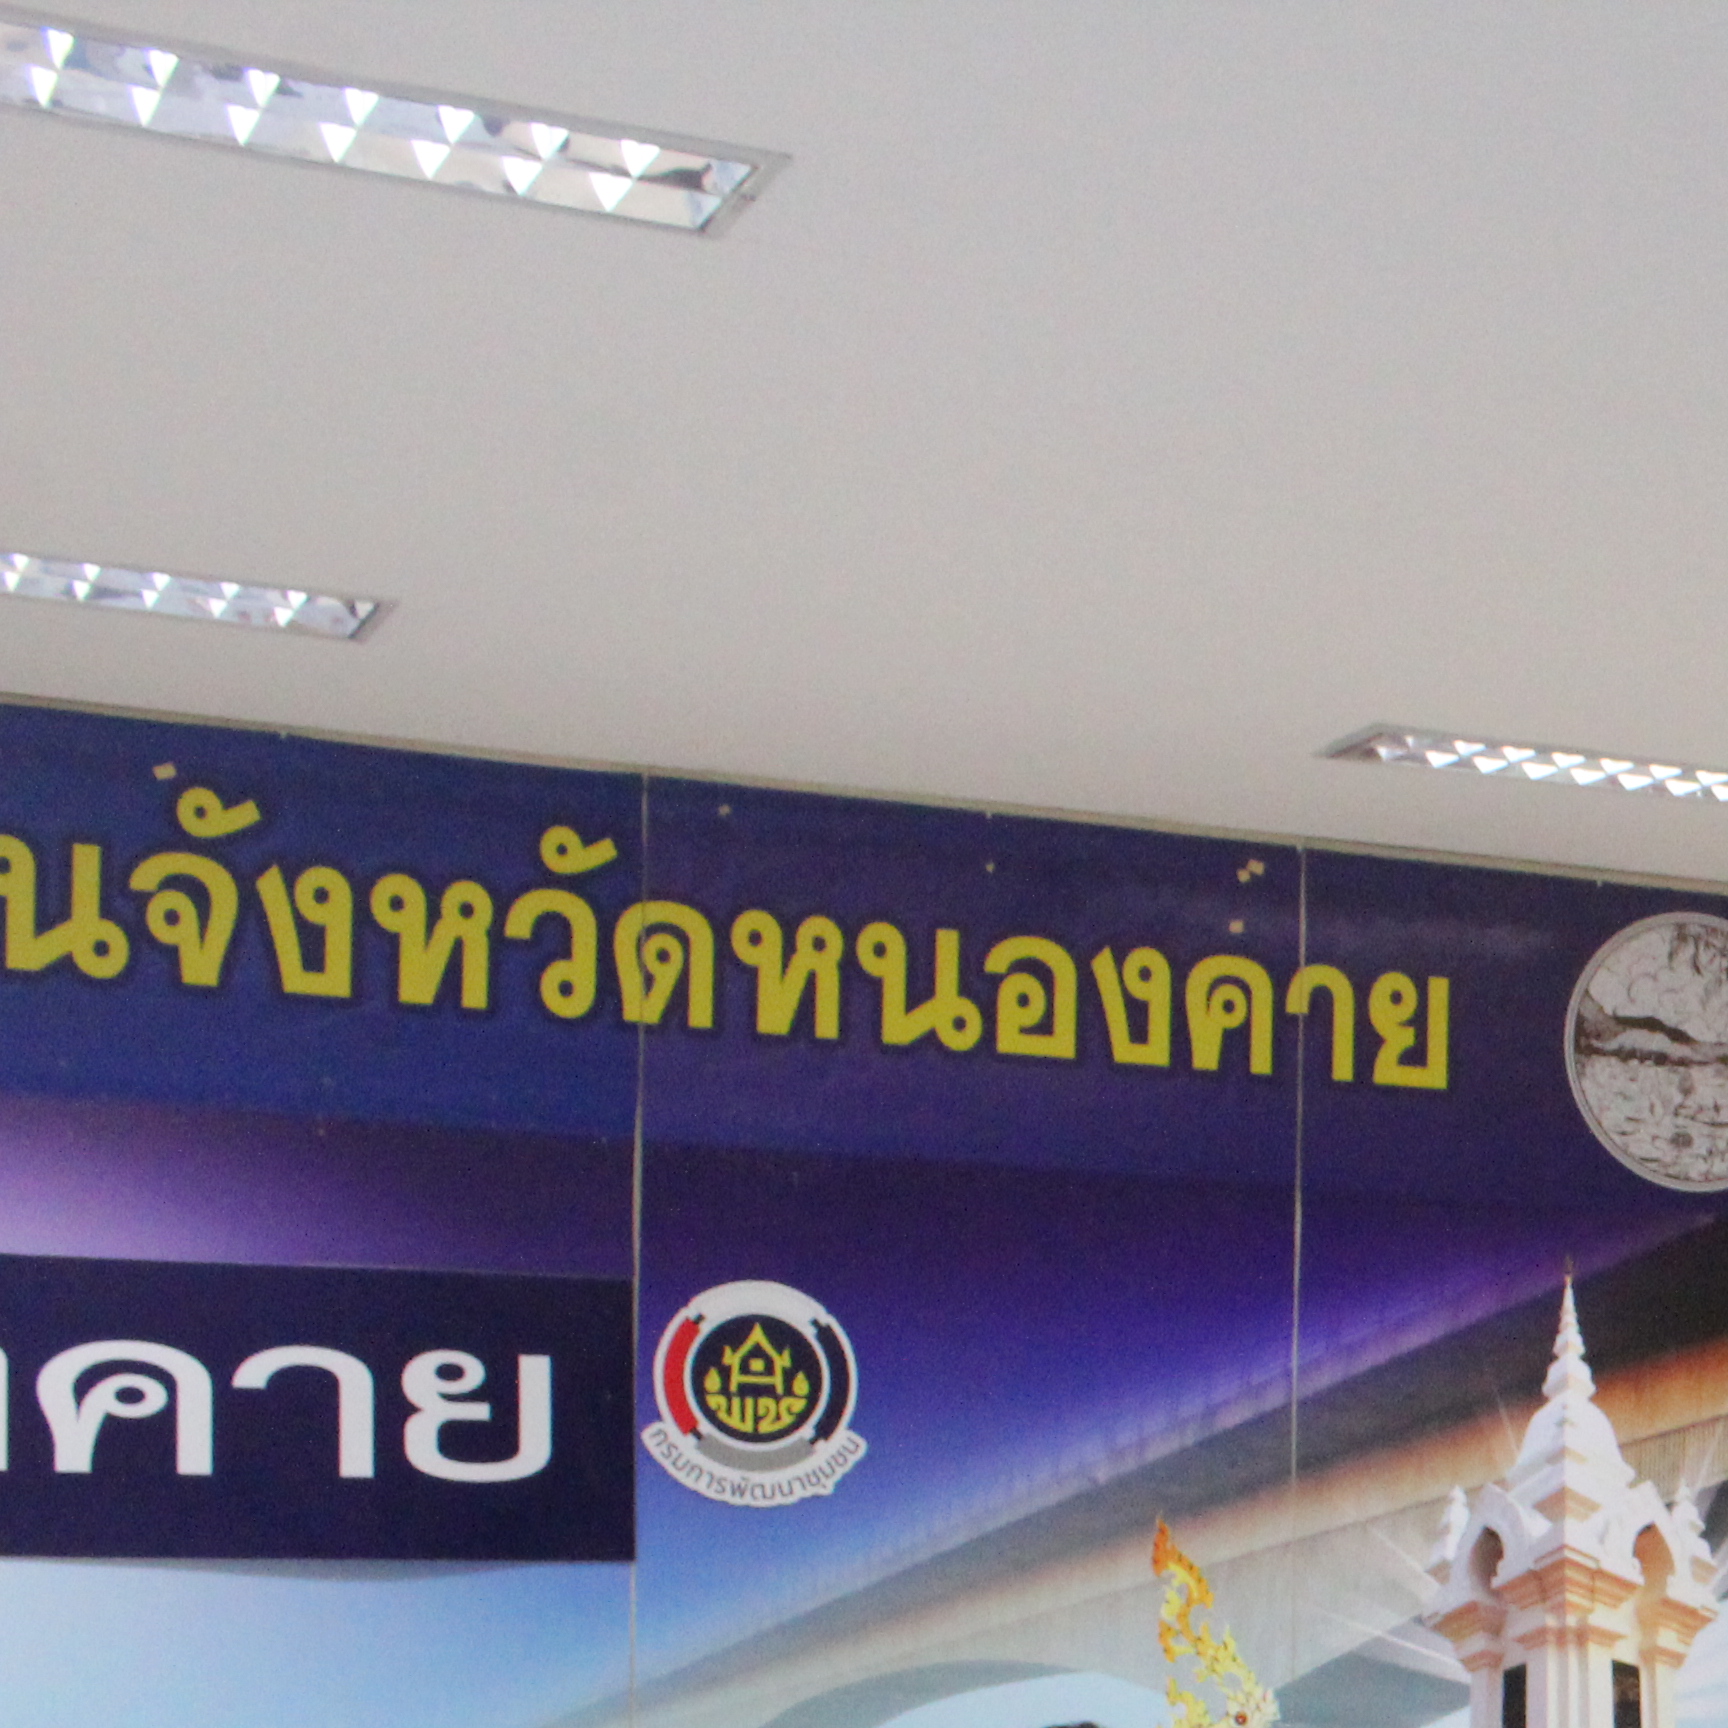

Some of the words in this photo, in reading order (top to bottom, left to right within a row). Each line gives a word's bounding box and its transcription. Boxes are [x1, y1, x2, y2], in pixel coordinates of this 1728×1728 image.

[0, 1339, 551, 1483] คาย
[649, 1428, 861, 1500] กรมการพัฒนาชุมชน
